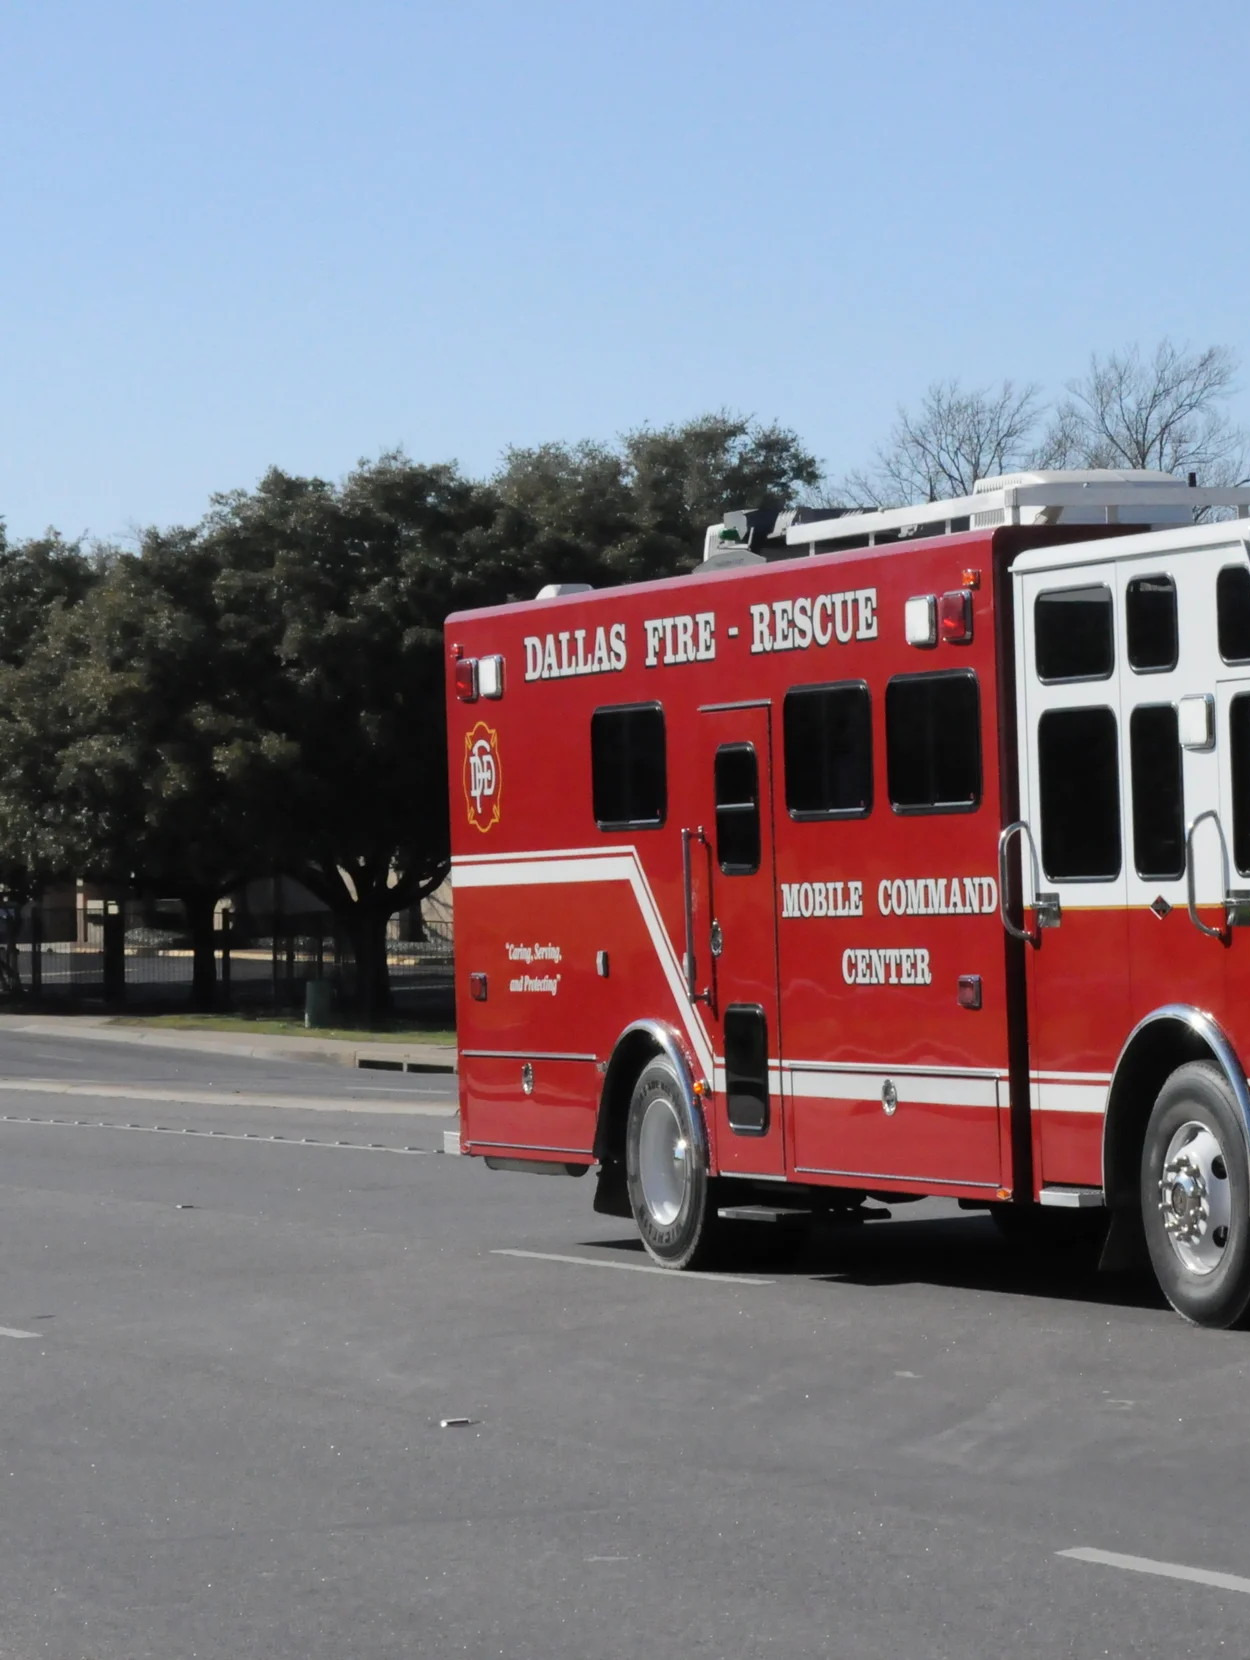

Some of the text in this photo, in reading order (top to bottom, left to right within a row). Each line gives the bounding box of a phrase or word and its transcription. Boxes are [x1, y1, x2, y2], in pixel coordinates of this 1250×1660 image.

[524, 623, 627, 683] DALLAS
[644, 612, 716, 669] FIRE
[750, 588, 878, 655] RESCUE
[781, 877, 998, 918] MOBILE COMMAND
[842, 948, 932, 985] CENTER
